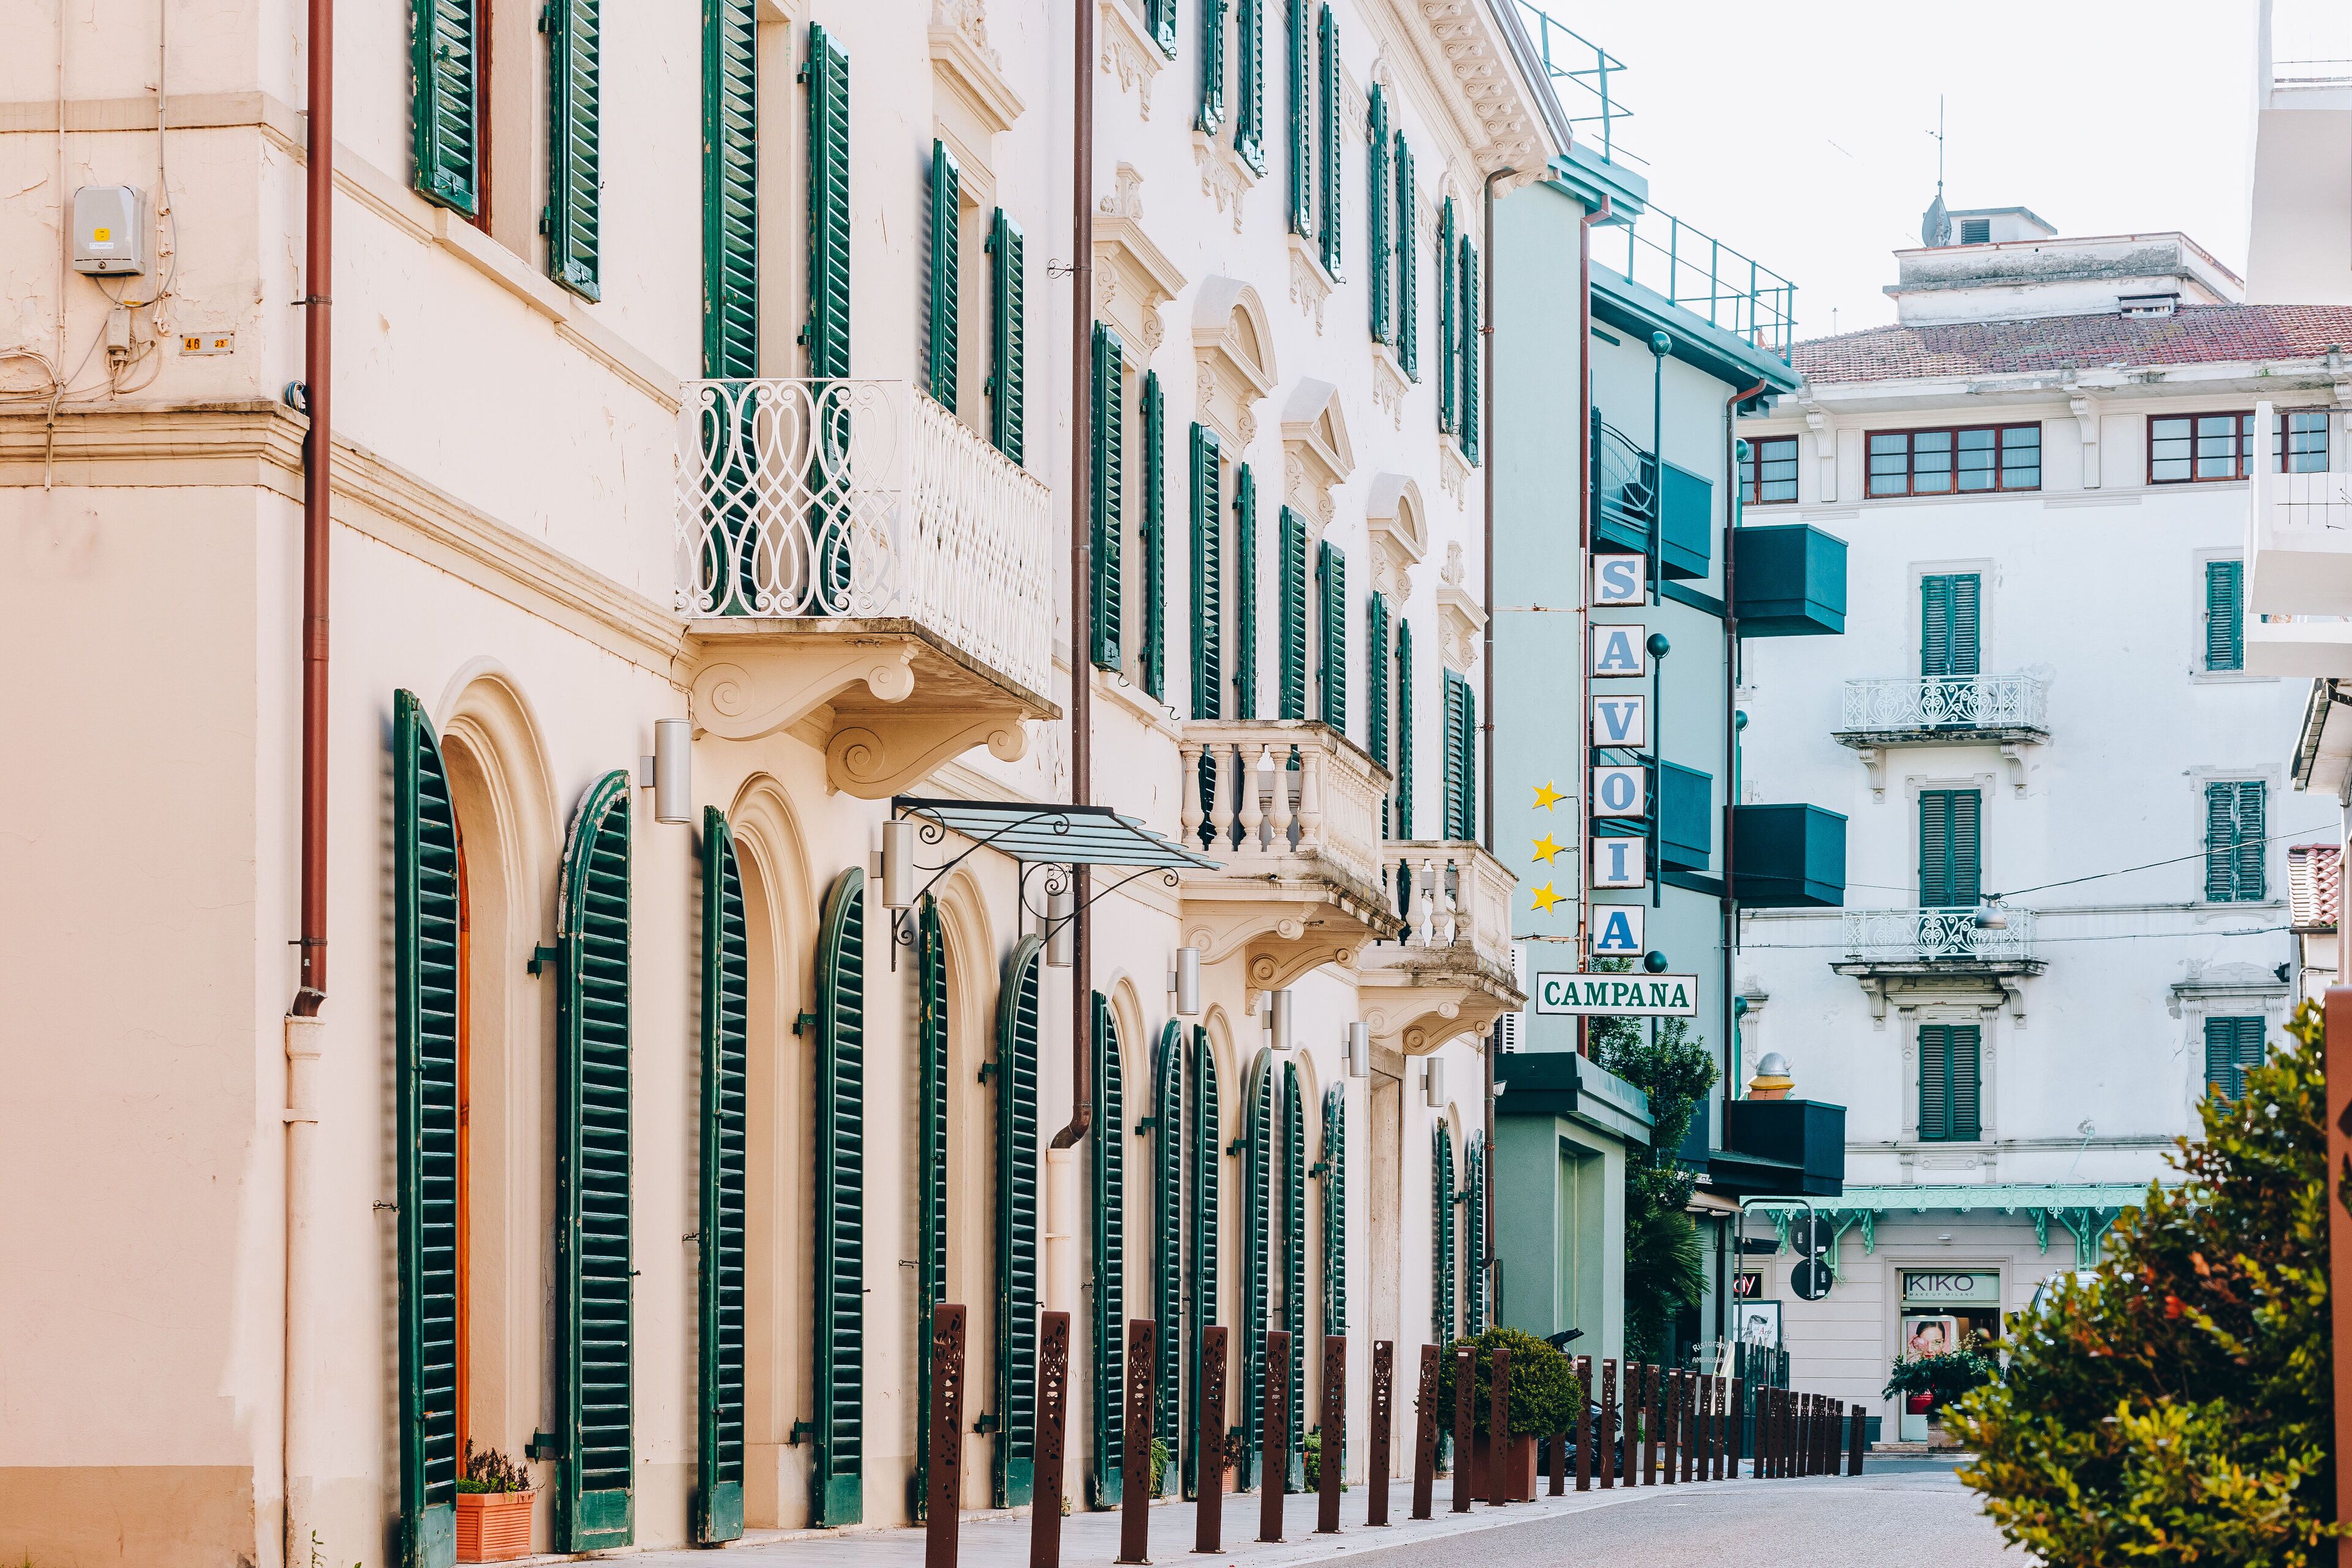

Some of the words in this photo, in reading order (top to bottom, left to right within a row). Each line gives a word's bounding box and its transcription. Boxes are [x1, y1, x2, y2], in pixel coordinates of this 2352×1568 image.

[186, 338, 200, 349] 46
[1597, 560, 1640, 949] SAVOIA
[1544, 981, 1690, 1008] CAMPANA
[1909, 1274, 1974, 1291] KIKO
[1692, 1340, 1728, 1352] Ristoran
